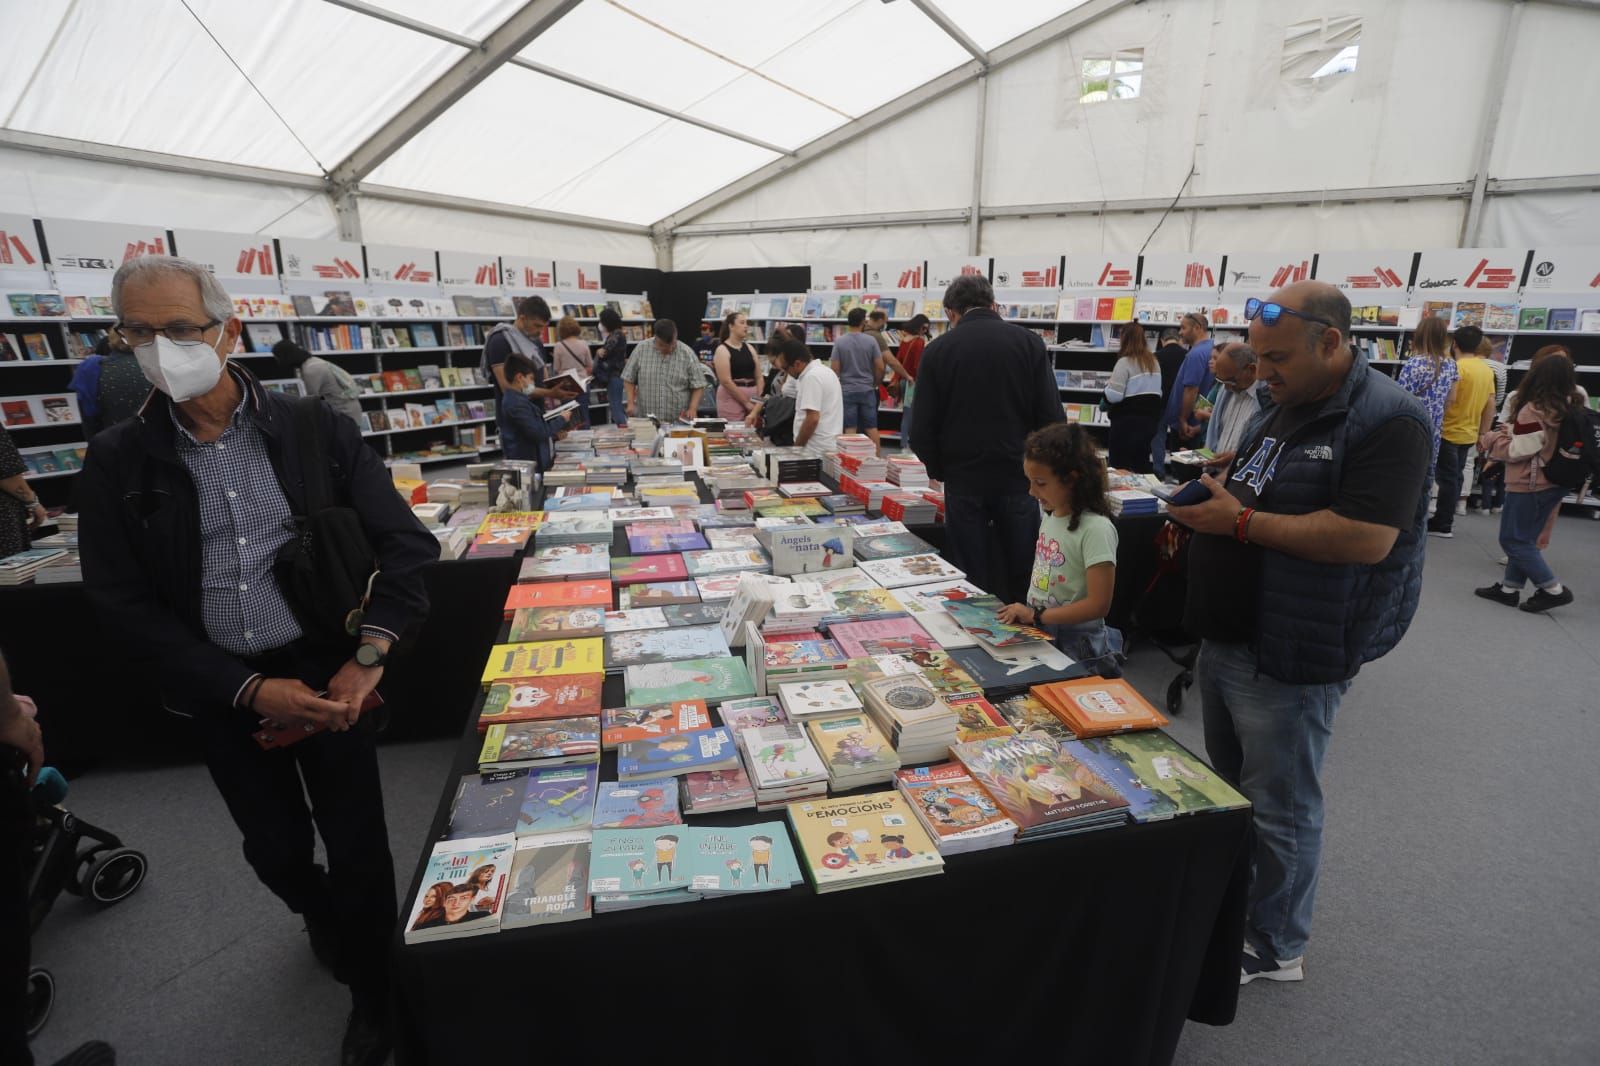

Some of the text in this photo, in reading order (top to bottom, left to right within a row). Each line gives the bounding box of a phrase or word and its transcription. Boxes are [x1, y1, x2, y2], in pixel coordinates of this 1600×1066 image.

[795, 543, 820, 553] nata
[983, 741, 1054, 763] MINA
[524, 892, 577, 906] TRIANGLE
[546, 901, 576, 911] ROSA
